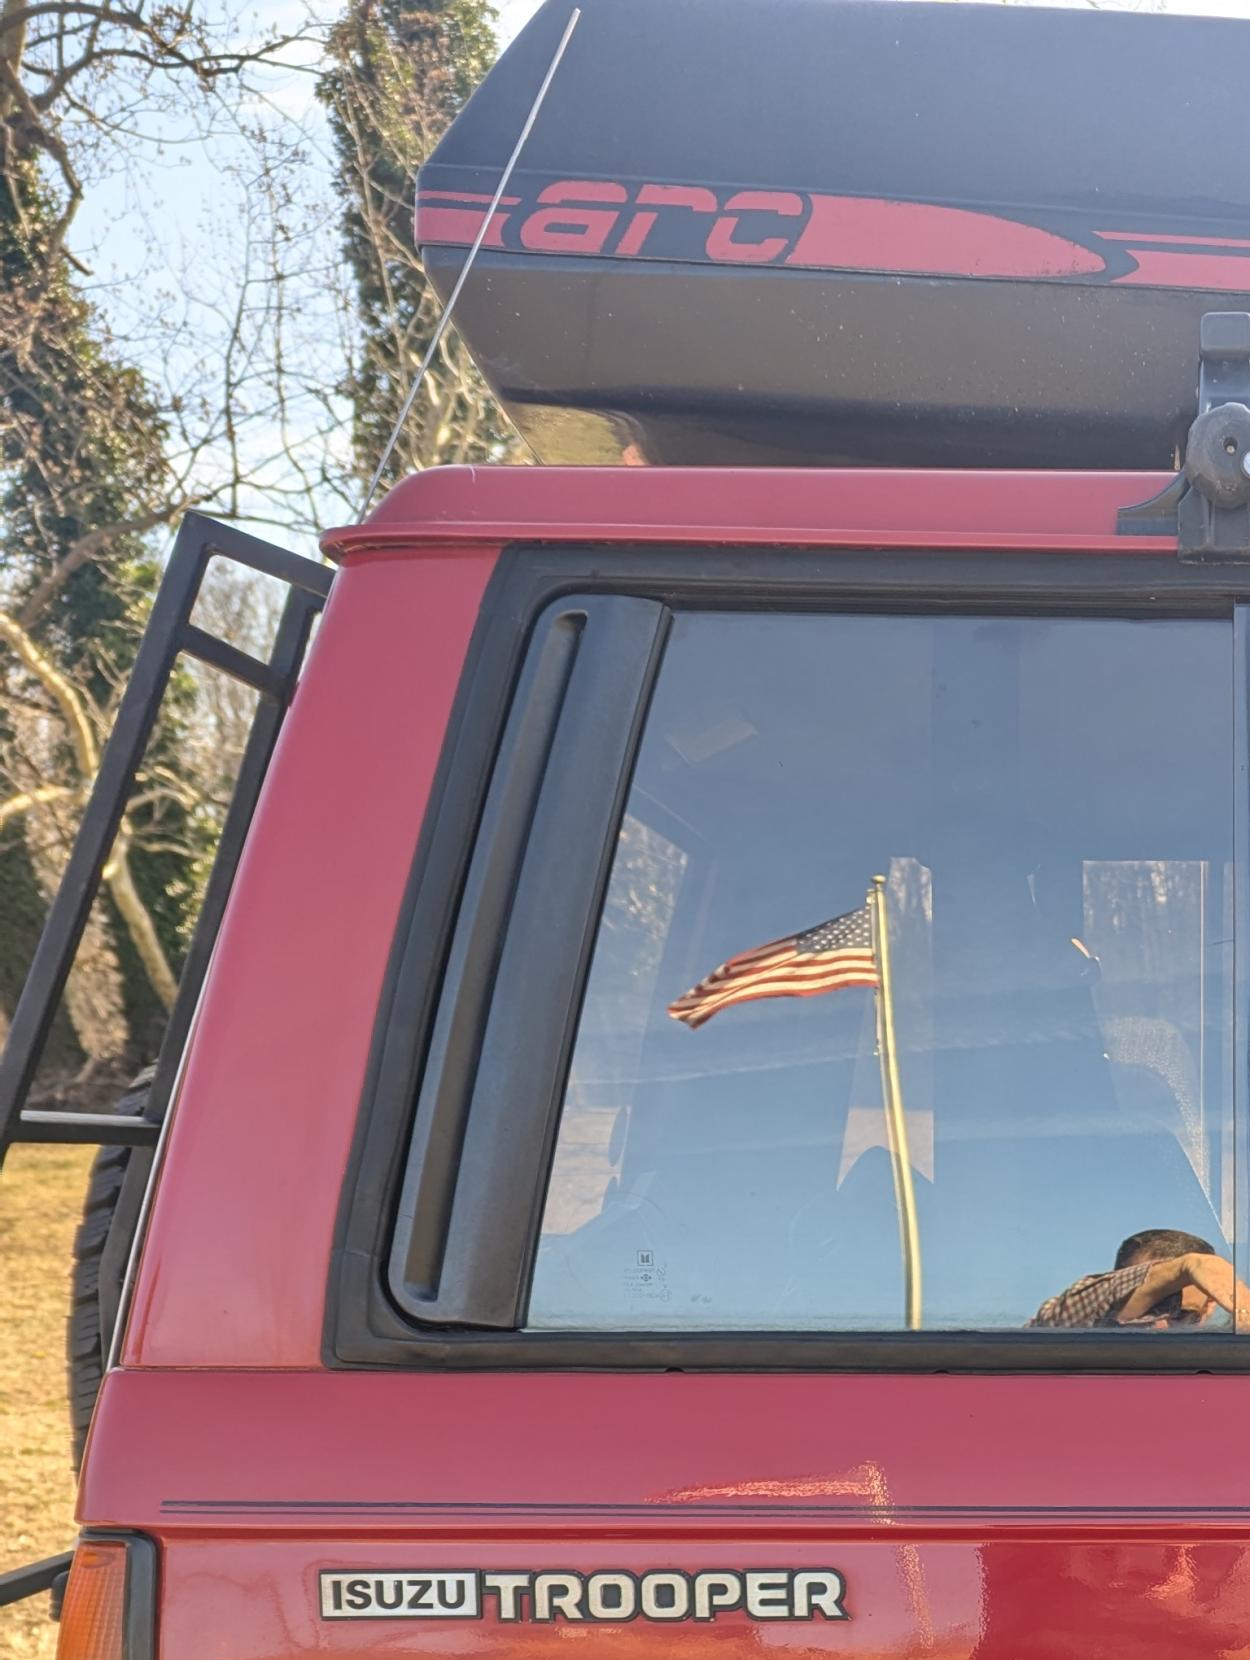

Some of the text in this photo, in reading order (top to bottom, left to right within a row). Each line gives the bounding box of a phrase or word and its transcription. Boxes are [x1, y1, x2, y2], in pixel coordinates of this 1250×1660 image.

[520, 180, 802, 265] arc
[331, 1570, 847, 1621] ISUZU TROOPER
